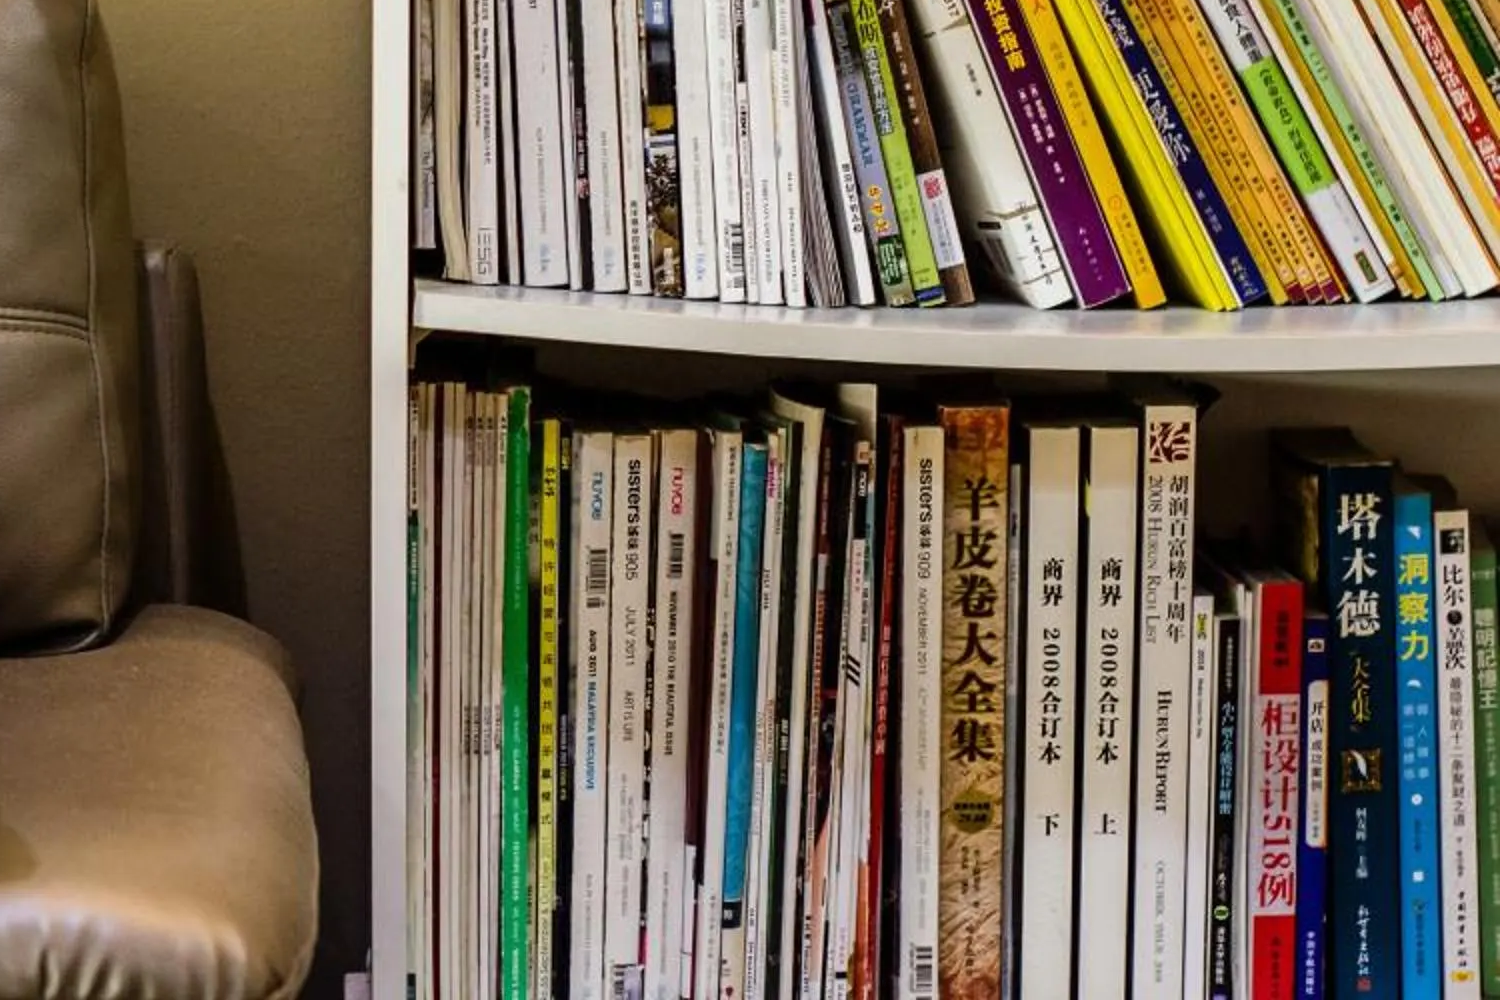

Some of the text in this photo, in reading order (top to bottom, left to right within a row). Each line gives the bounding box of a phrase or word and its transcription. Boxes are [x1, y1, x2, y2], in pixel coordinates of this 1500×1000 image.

[1147, 475, 1162, 513] 2008
[624, 553, 638, 581] 905
[917, 552, 930, 579] 909
[1337, 493, 1383, 640] 塔木德
[624, 606, 636, 638] JULY
[917, 587, 928, 648] NOVEMBER
[949, 477, 1001, 764] 羊皮卷大全集
[1398, 552, 1430, 662] 洞察力
[624, 639, 636, 667] 2011
[586, 680, 597, 732] MALAYSIA
[623, 690, 635, 711] ART
[665, 683, 676, 728] BEAUTIFUL
[1038, 558, 1064, 837] 商界 2008合订本 下
[1094, 558, 1123, 836] 商界 2008合订本 上
[585, 735, 596, 790] EXCLUSIVE
[1155, 751, 1171, 815] REPORT
[1257, 699, 1298, 909] 柜设计518例
